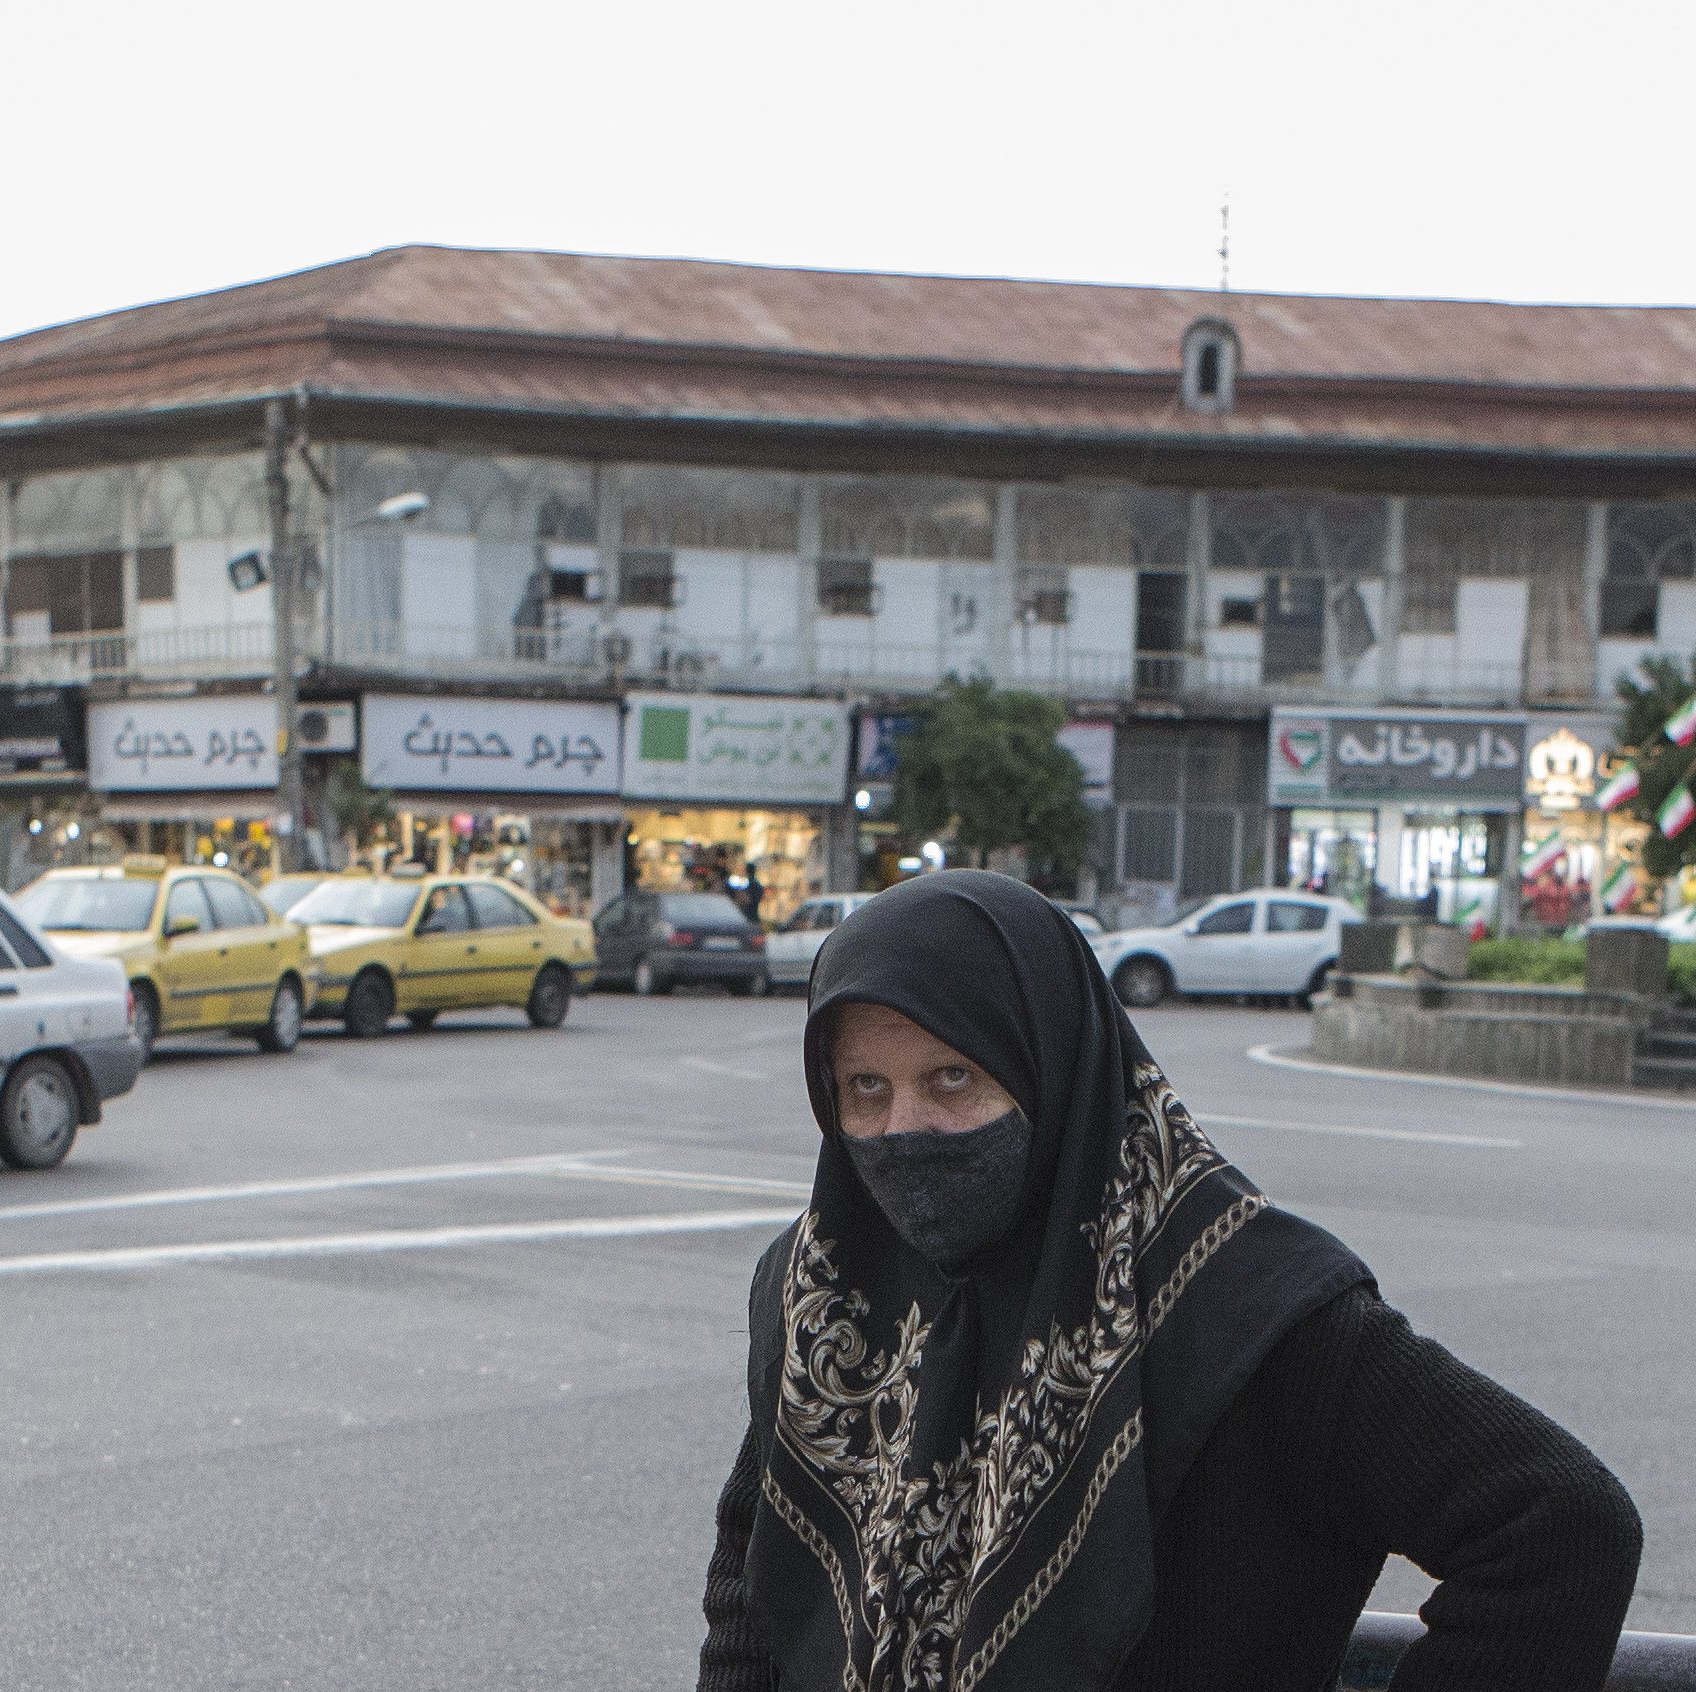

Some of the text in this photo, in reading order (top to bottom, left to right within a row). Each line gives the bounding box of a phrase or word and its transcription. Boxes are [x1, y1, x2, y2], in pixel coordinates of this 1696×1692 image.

[113, 715, 195, 775] حدیث
[203, 728, 267, 770] چرم
[403, 713, 605, 777] چرم حدیث
[1336, 723, 1521, 779] داروخانه
